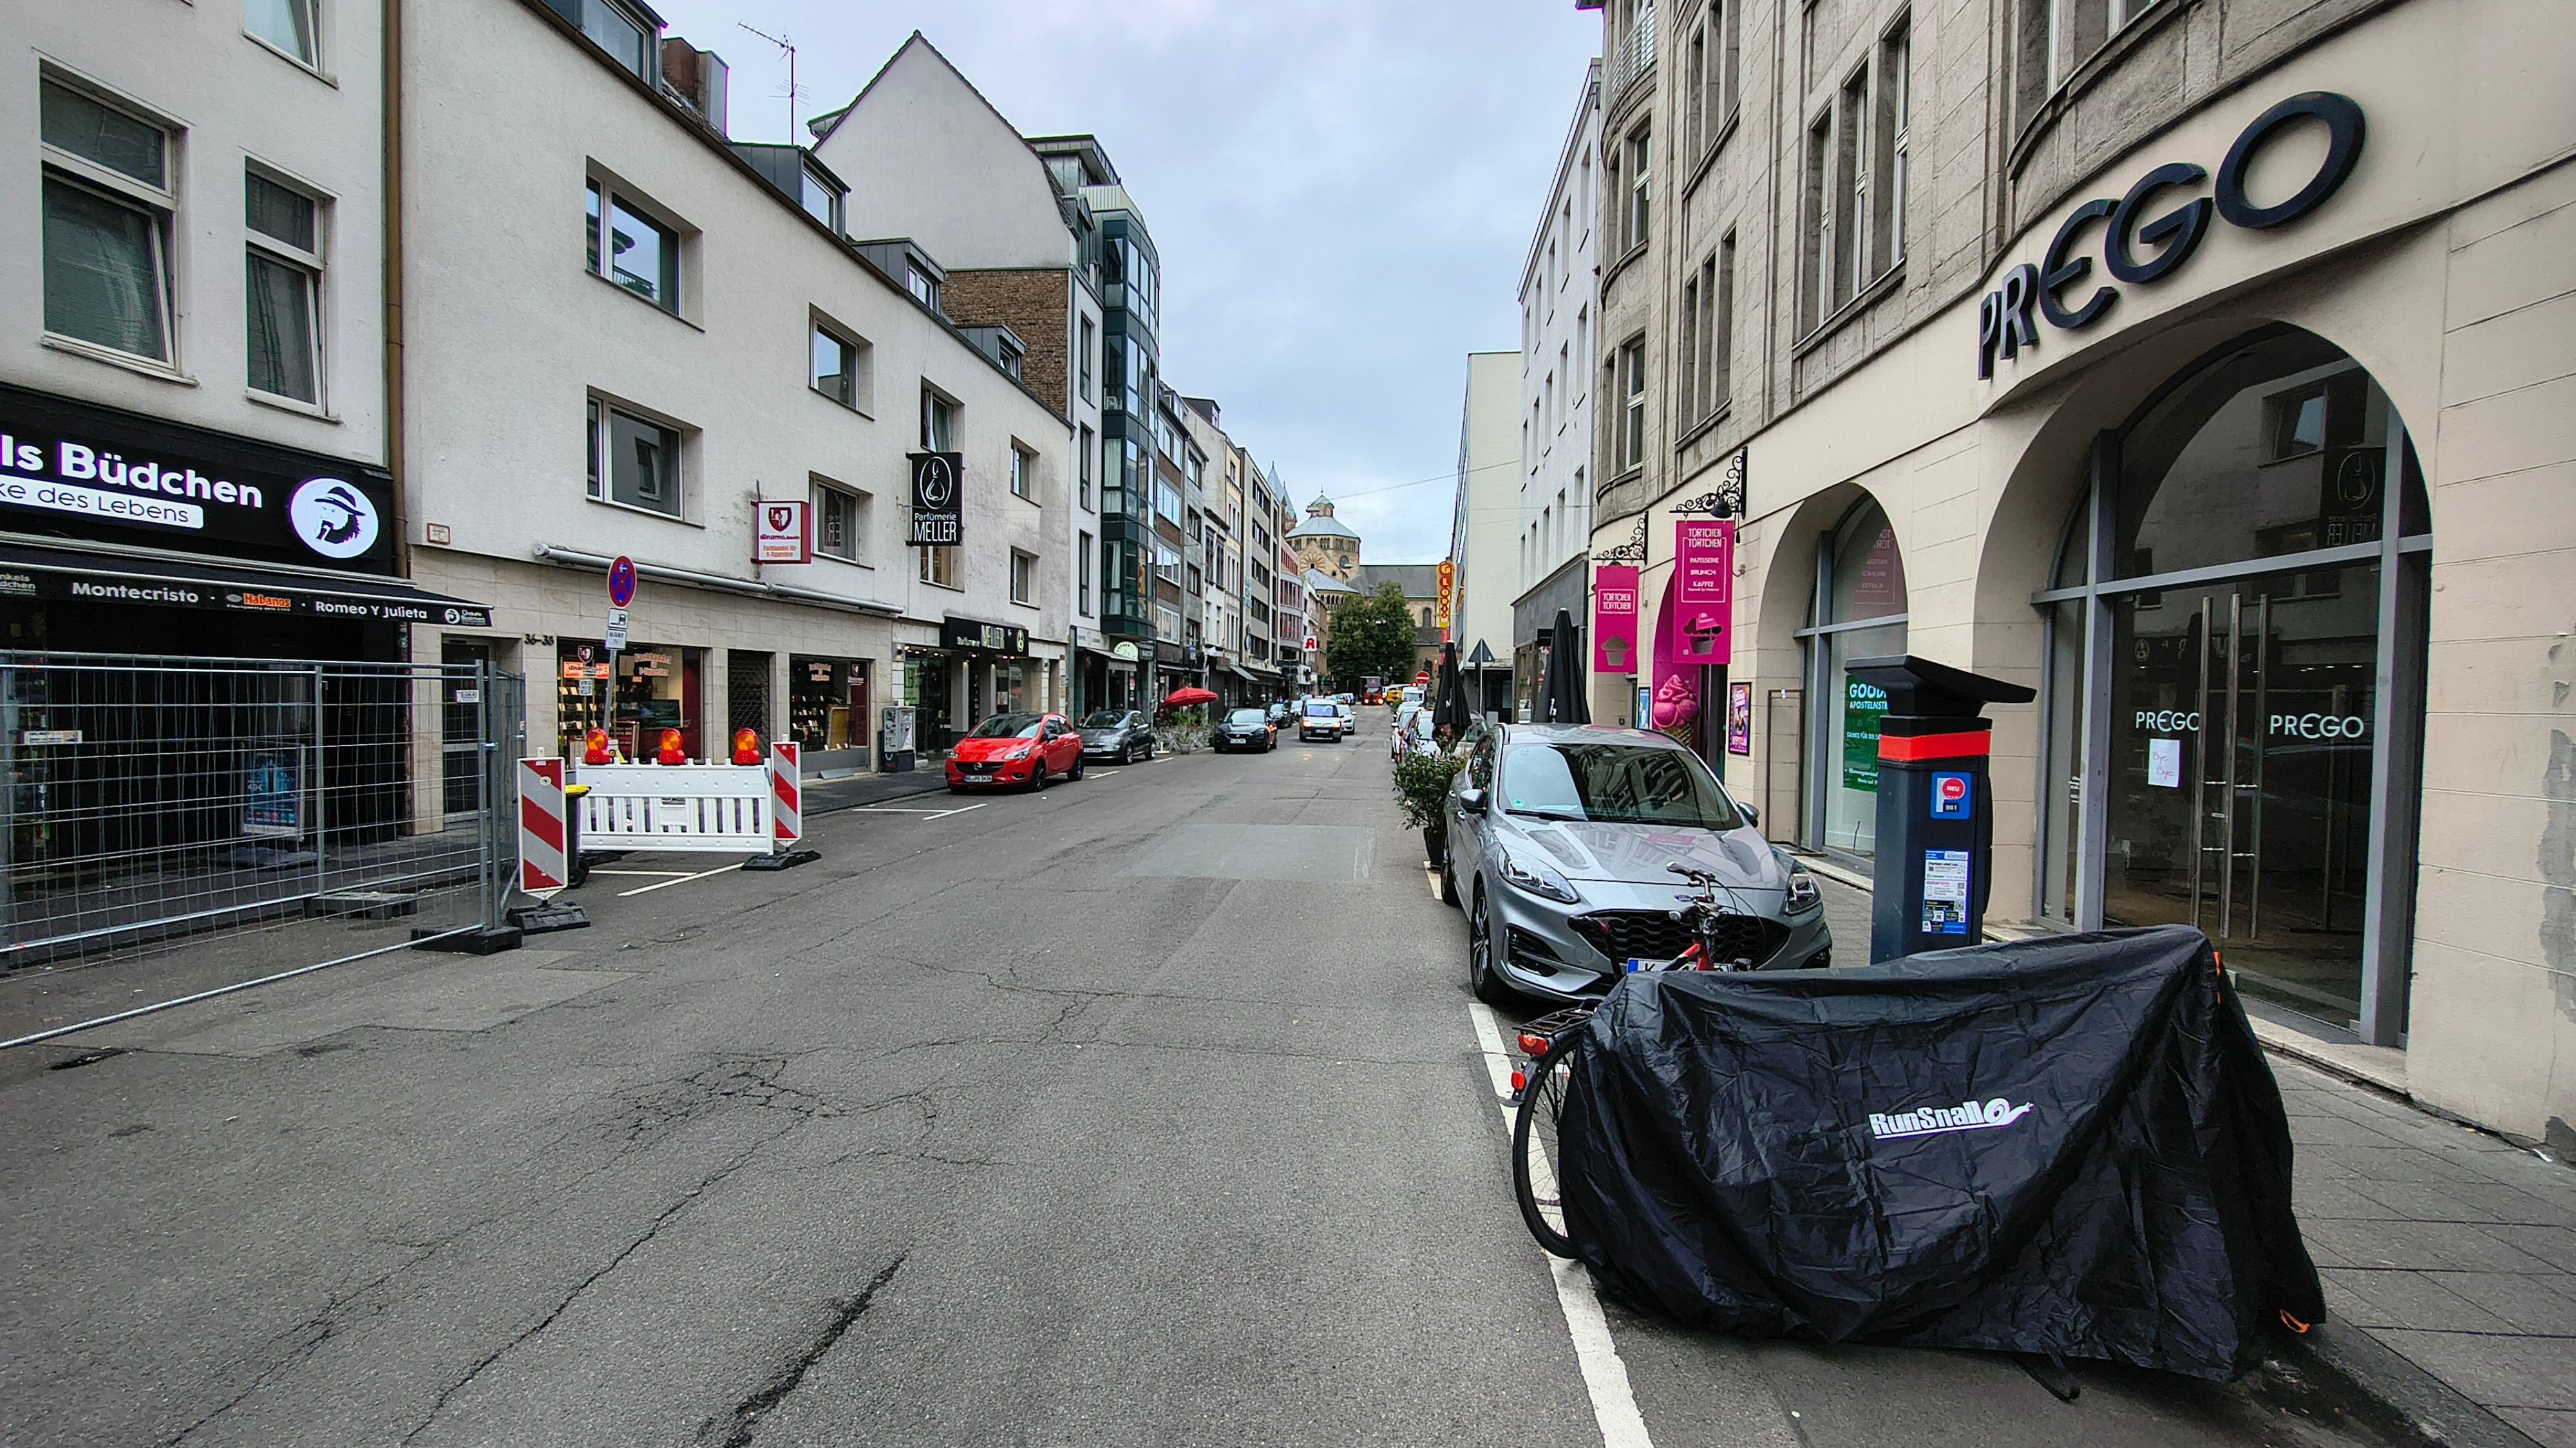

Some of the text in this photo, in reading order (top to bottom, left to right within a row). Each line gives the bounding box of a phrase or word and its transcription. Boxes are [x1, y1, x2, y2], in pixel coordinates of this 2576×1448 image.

[1978, 90, 2366, 381] PREGO
[60, 442, 263, 508] Büdchen
[38, 487, 89, 509] des
[98, 496, 189, 523] Lebens
[914, 522, 956, 541] MELLER
[72, 581, 199, 603] Montecristo
[243, 592, 292, 608] Habanos
[316, 601, 428, 619] Romeo Y Julieta
[1850, 683, 1887, 699] GOOD
[2269, 713, 2364, 738] PREGO
